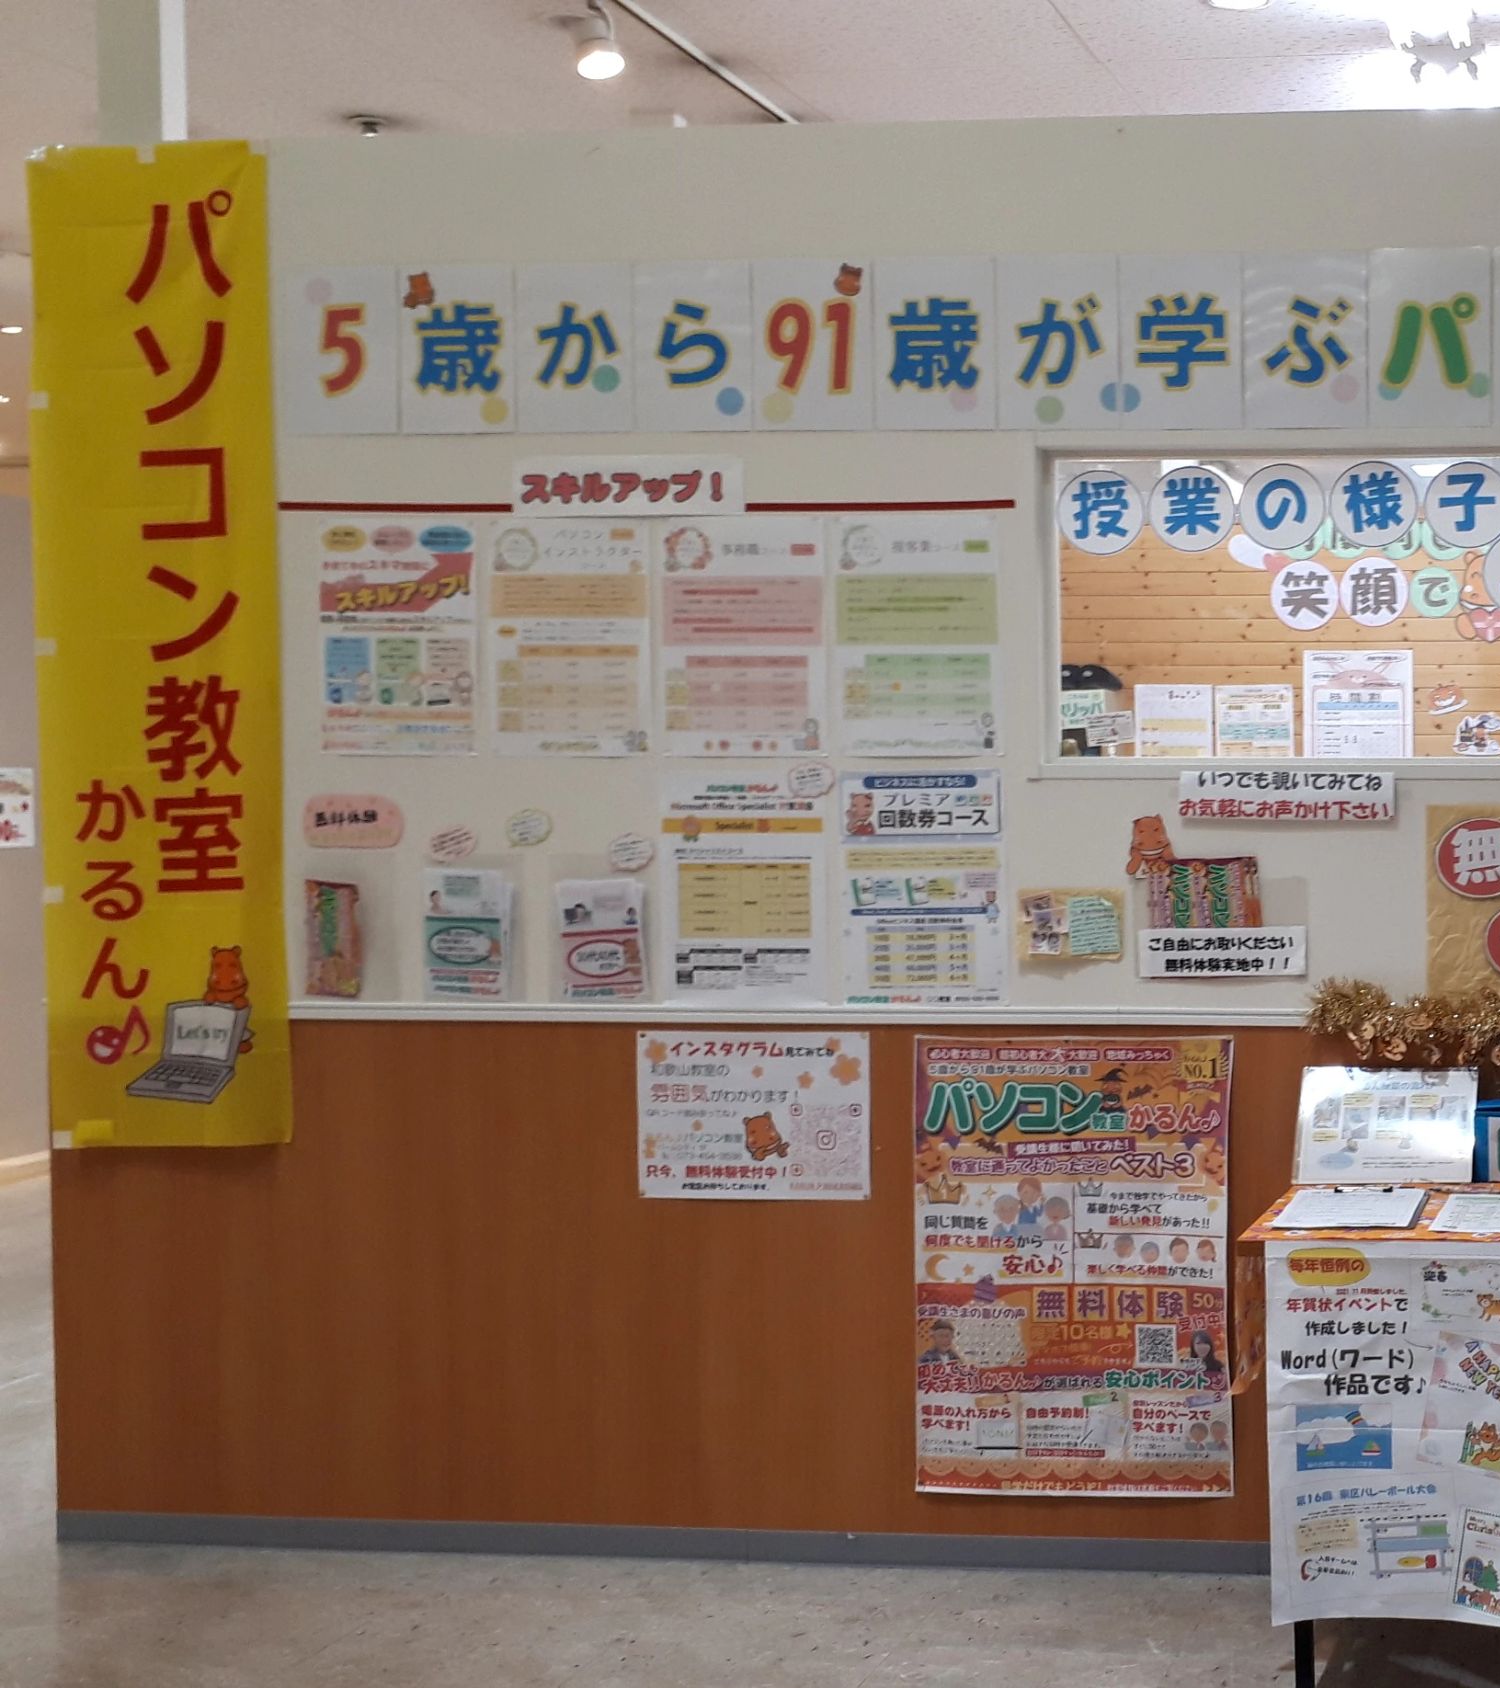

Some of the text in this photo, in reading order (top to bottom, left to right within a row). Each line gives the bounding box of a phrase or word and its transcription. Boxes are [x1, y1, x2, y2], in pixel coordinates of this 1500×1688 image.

[1071, 470, 1496, 539] 授業の様子
[125, 189, 246, 893] パソコン教室
[1199, 771, 1383, 792] いつでも覗いてみてね
[878, 808, 990, 829] 回数券コース
[1148, 936, 1294, 952] ご自由にお取りください
[1110, 1151, 1196, 1178] ベスト3
[923, 1215, 989, 1230] 同じ質問を
[1036, 1289, 1186, 1319] 無料体験
[1286, 1297, 1409, 1313] 年賀状イベントで
[1305, 1321, 1409, 1336] 作成しました!
